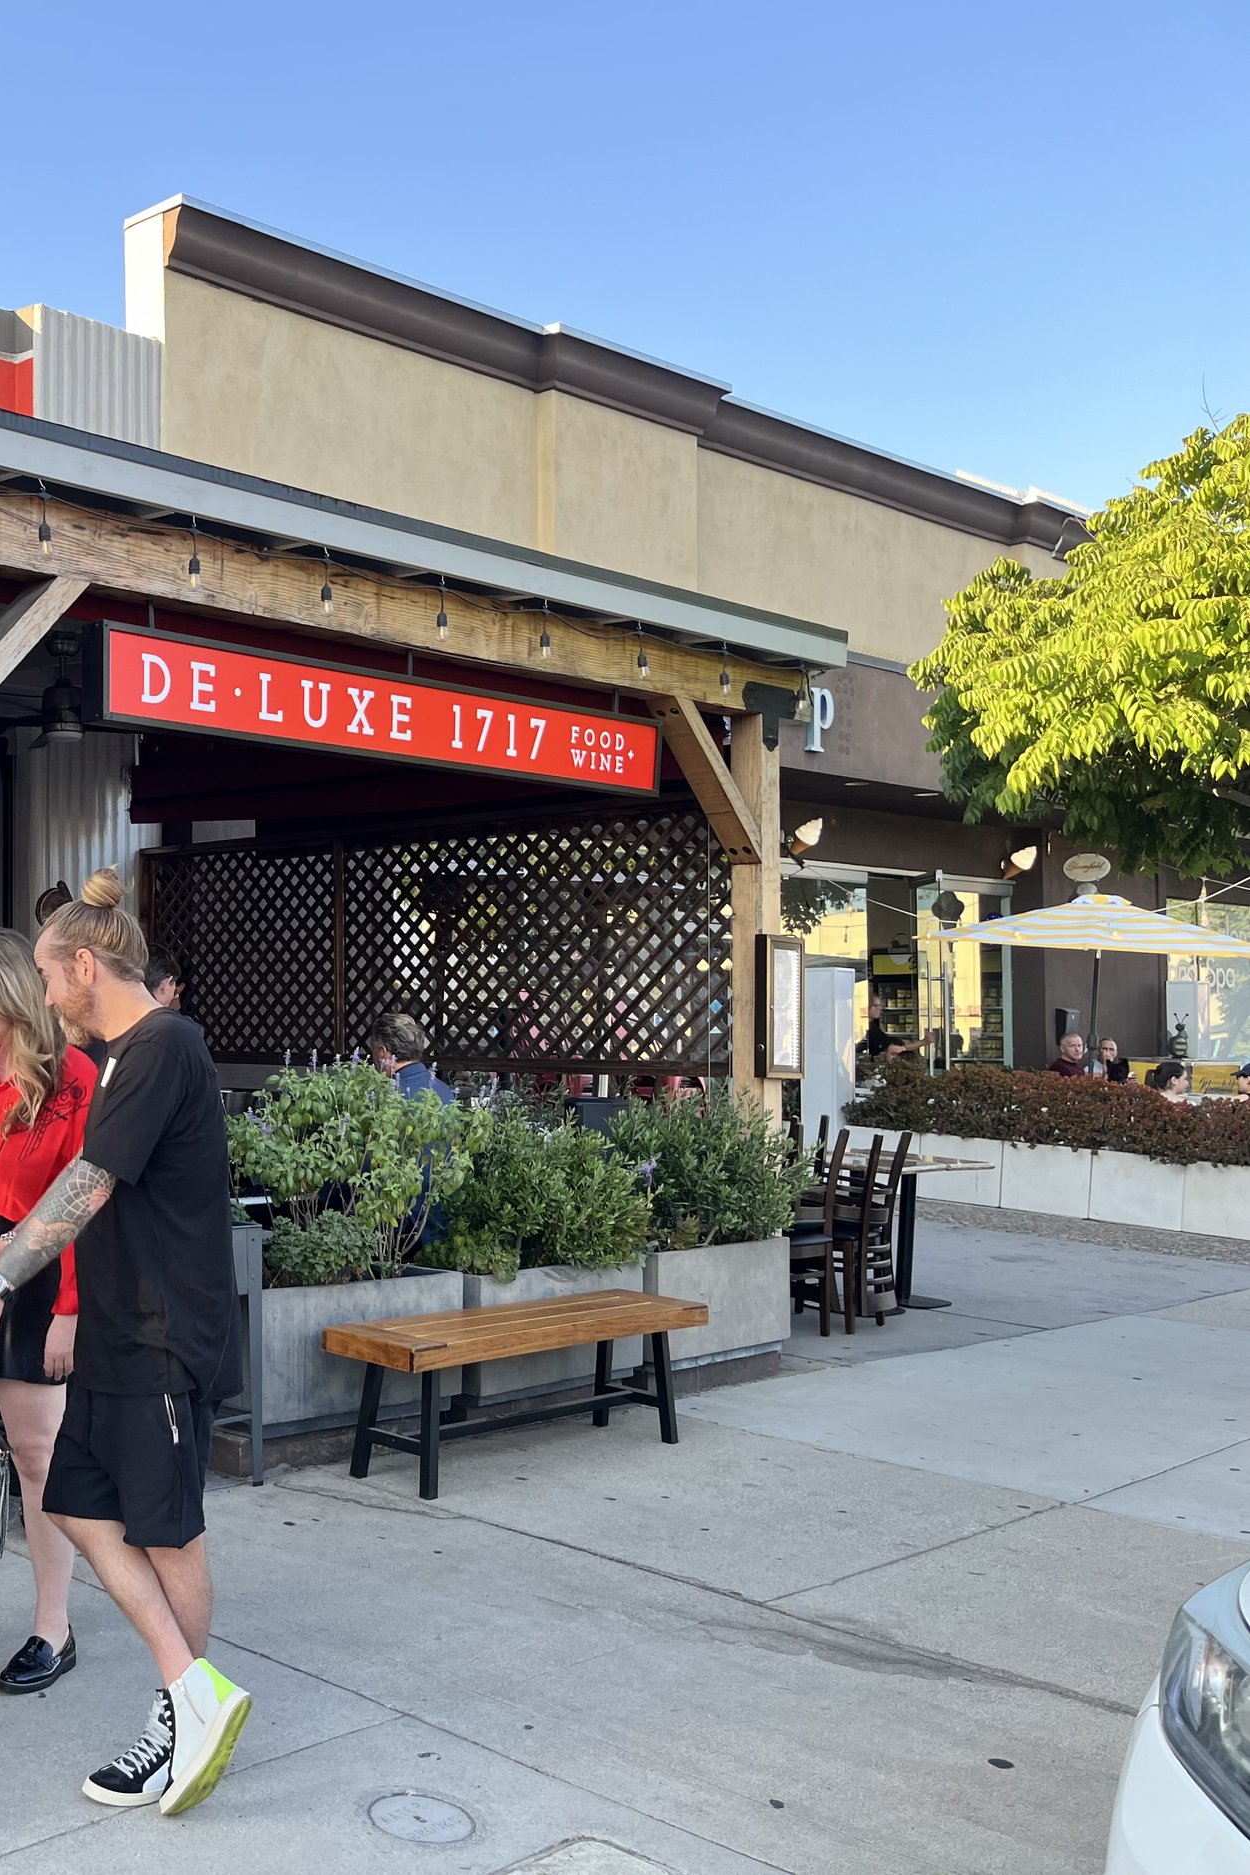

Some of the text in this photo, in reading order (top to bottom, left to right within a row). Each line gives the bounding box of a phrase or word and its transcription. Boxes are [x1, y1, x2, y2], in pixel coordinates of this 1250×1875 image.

[451, 704, 547, 760] 1717
[571, 725, 625, 751] FOOD
[570, 748, 624, 774] WINE
[1207, 956, 1235, 994] Spa
